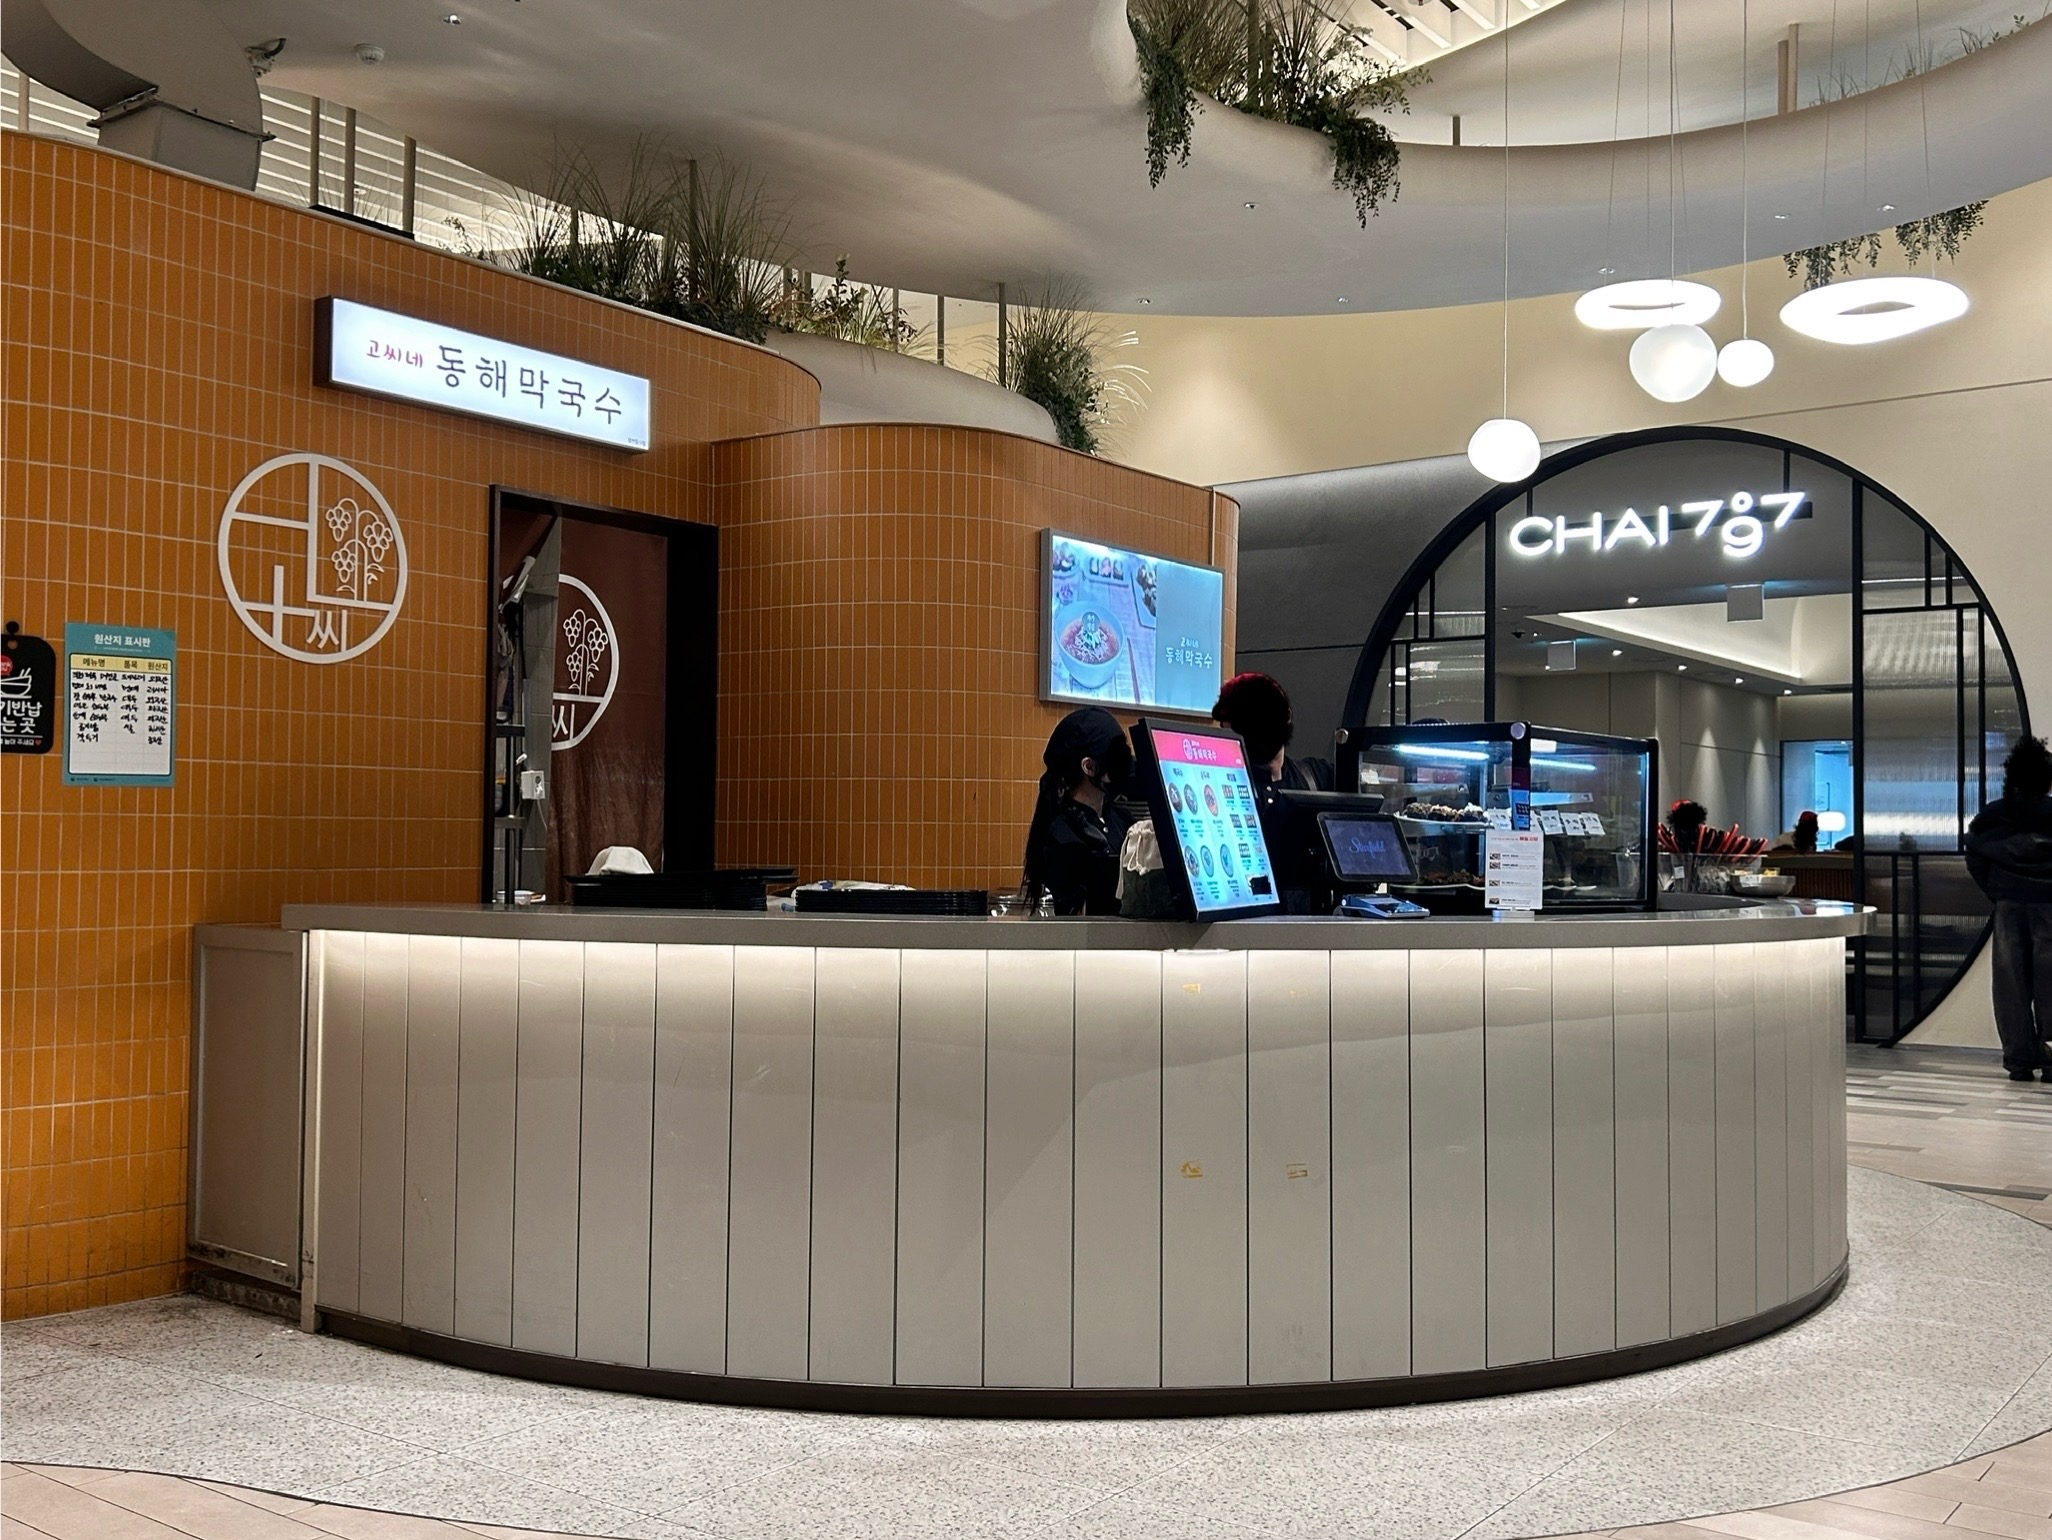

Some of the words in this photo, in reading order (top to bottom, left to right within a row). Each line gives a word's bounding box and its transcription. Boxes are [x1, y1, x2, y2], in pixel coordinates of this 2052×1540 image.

[366, 339, 424, 369] 고씨네
[436, 344, 623, 425] 동해막국수
[1509, 505, 1669, 557] CHAI
[94, 634, 122, 646] 원산지
[124, 636, 151, 648] 표시판
[82, 657, 106, 667] 메뉴명
[124, 660, 138, 669] 품목
[148, 661, 168, 671] 원산지
[1165, 646, 1213, 669] 동해막국수
[19, 717, 36, 734] 곳
